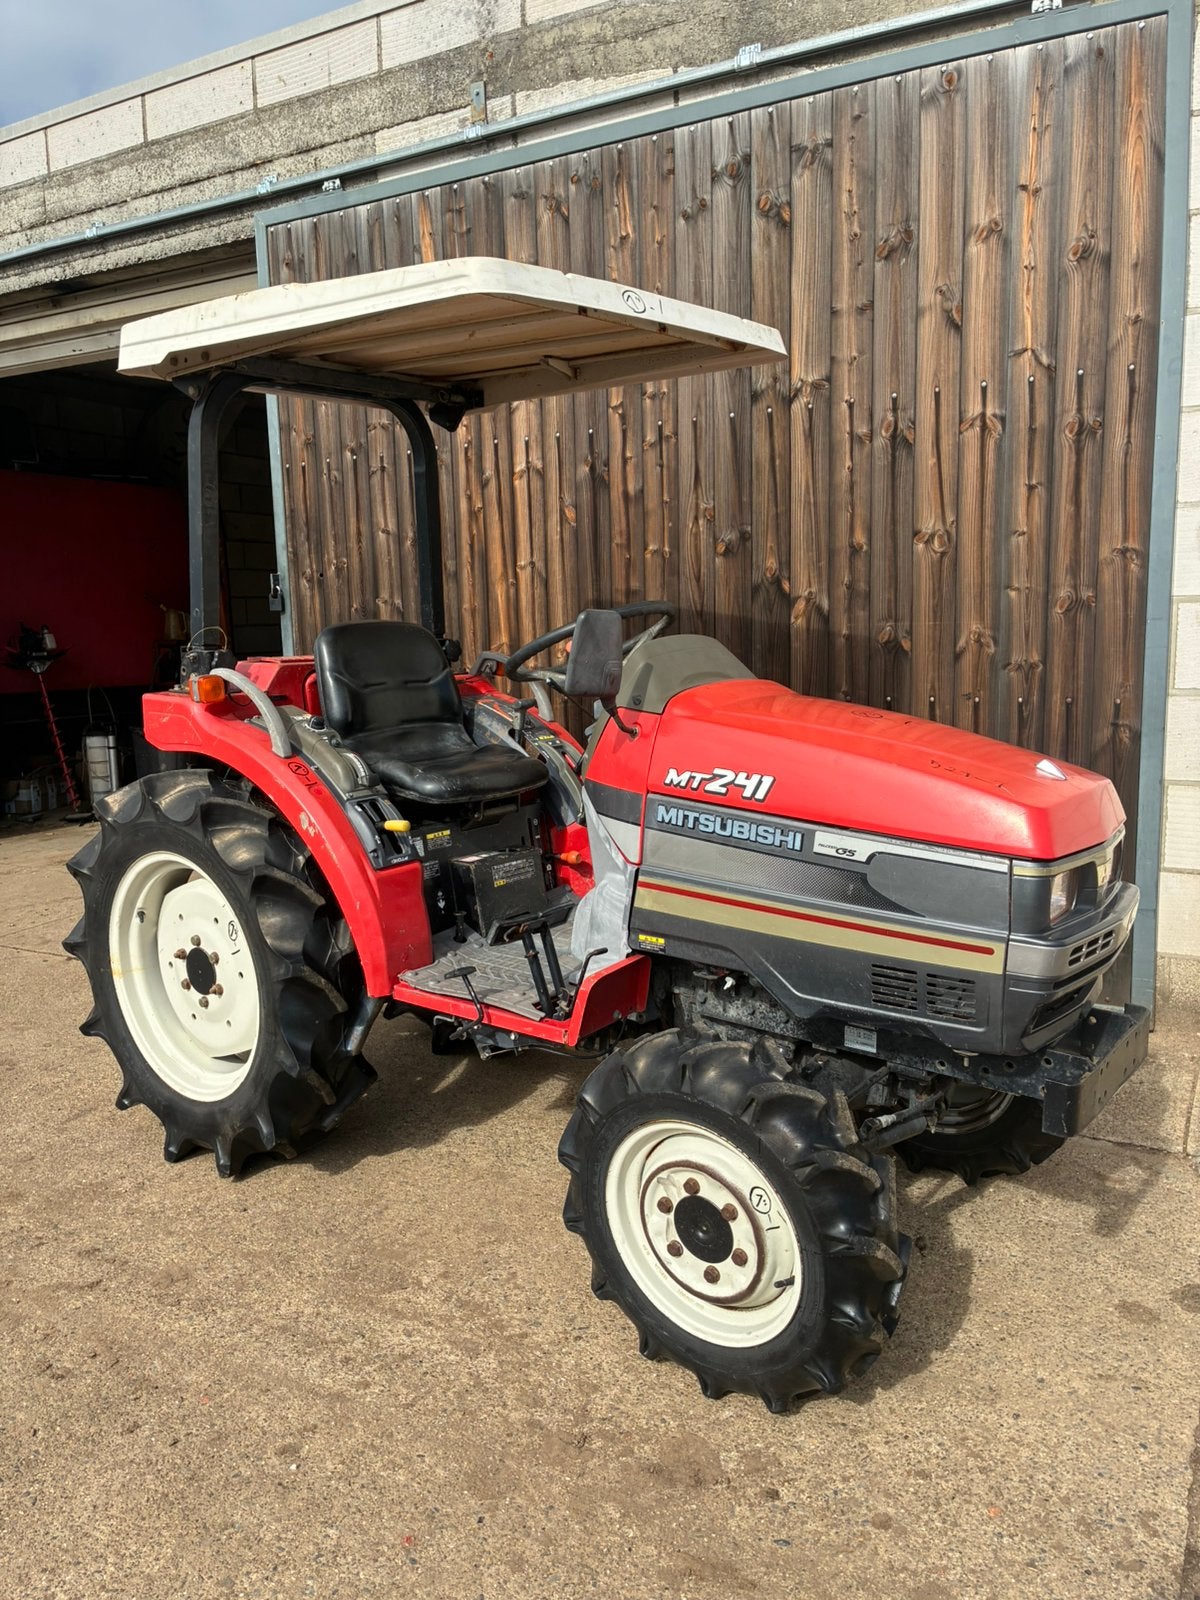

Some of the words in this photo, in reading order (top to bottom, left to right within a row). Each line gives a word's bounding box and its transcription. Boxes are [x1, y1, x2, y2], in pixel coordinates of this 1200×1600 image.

[664, 767, 776, 802] MT241
[656, 804, 804, 852] MITSUBISHI
[835, 847, 857, 857] GS
